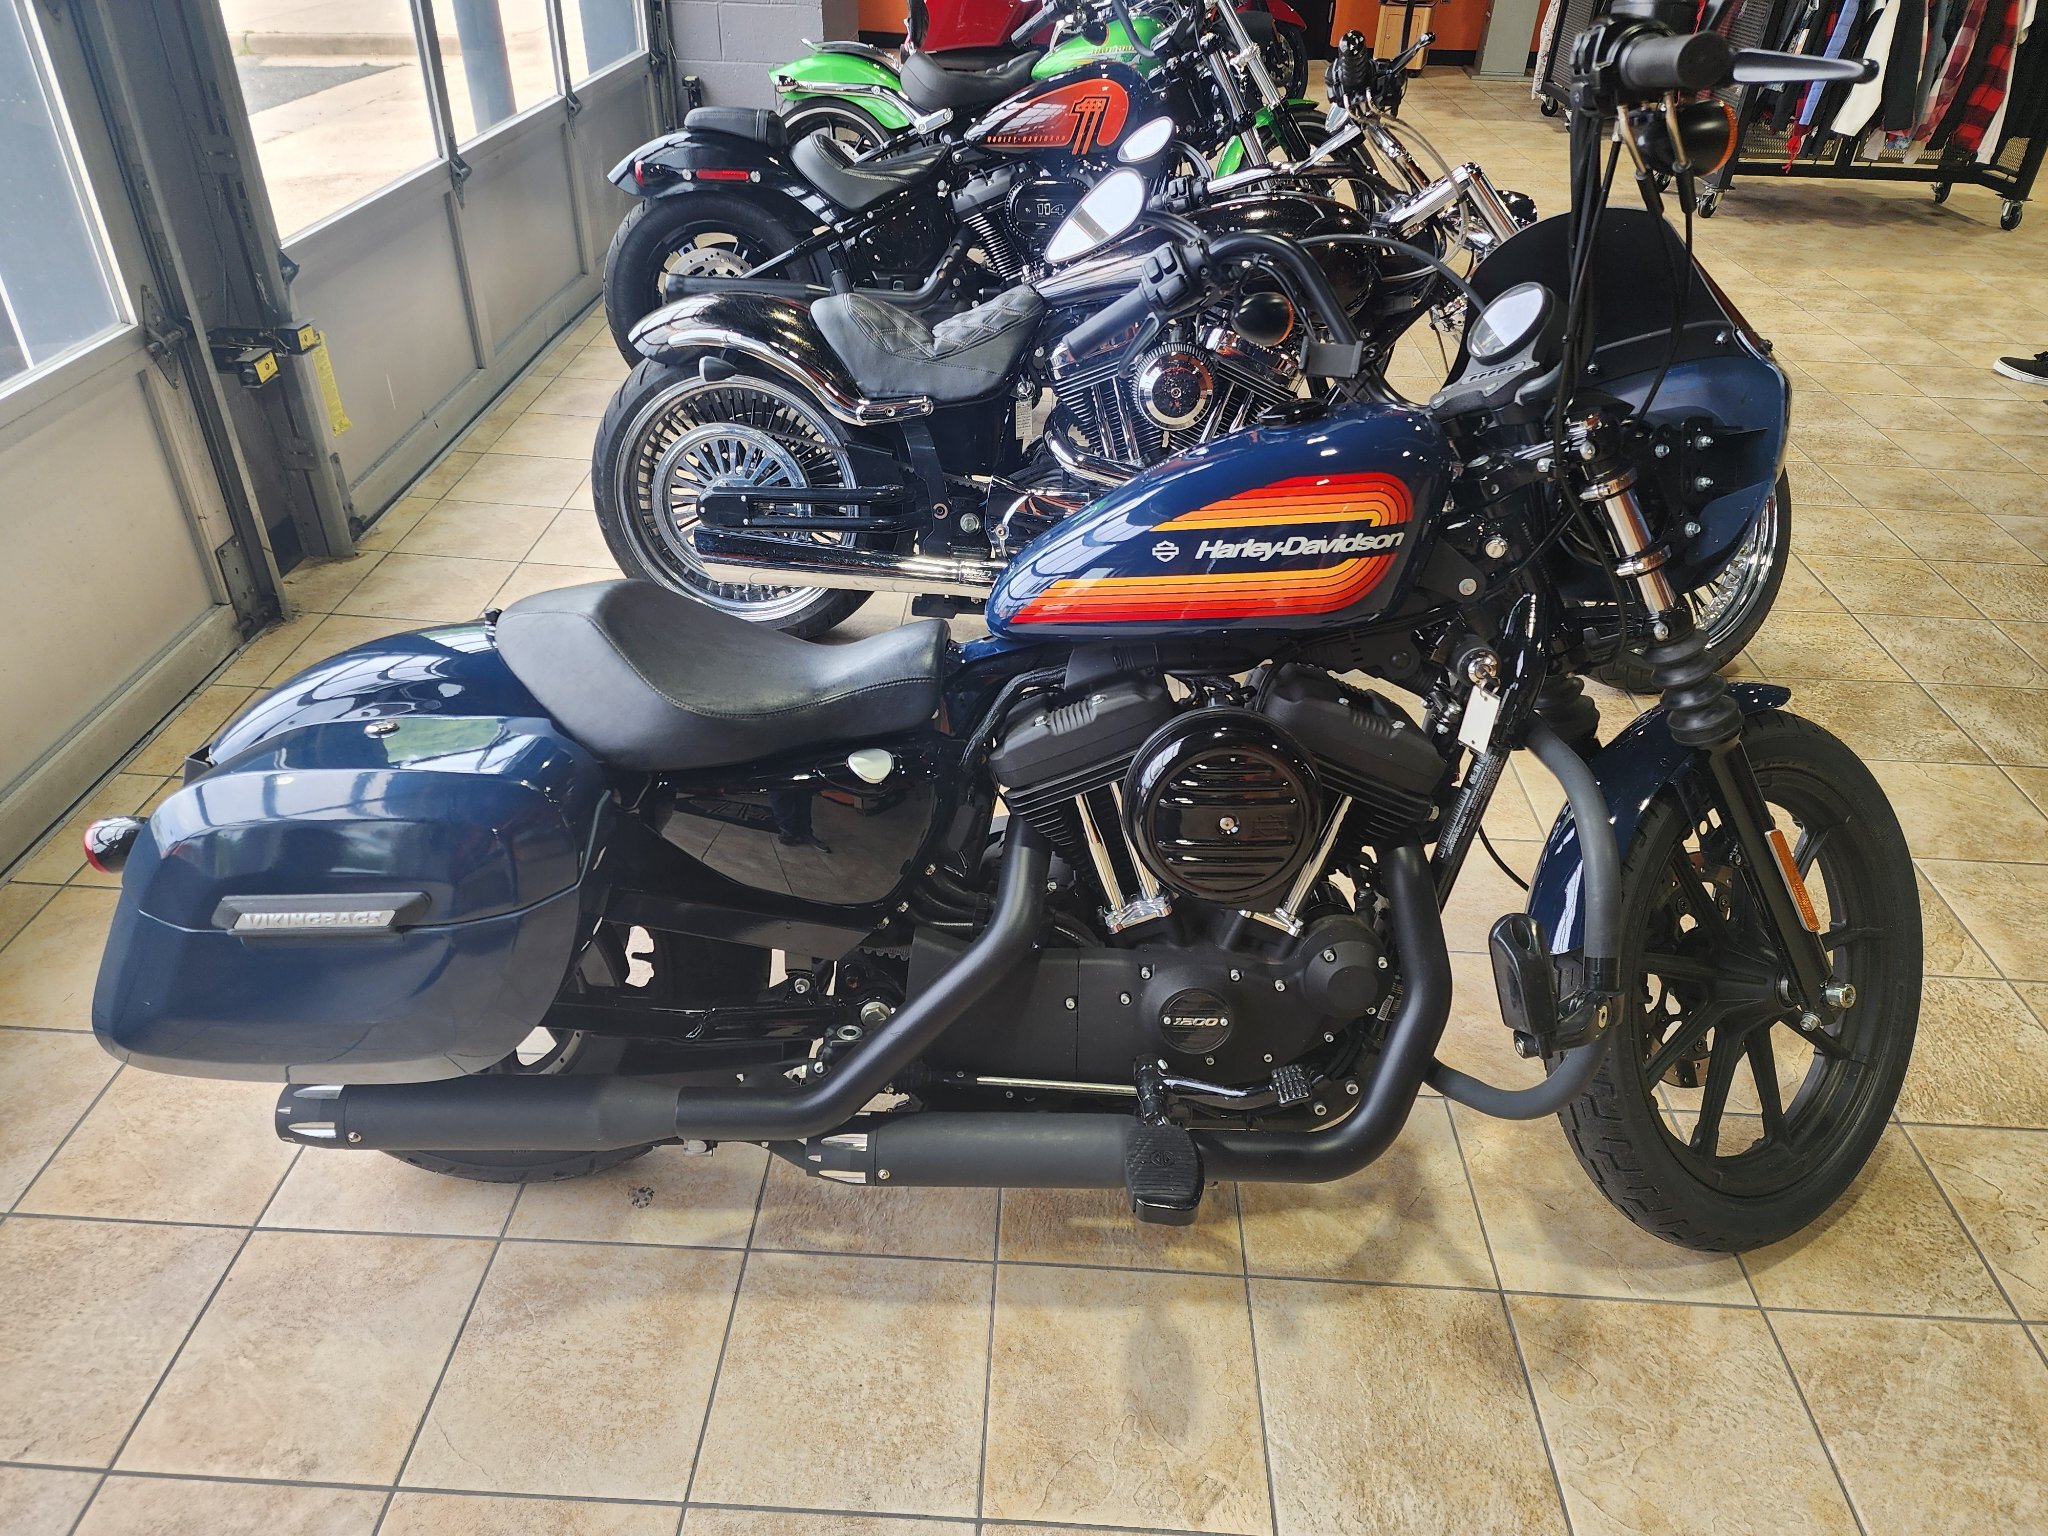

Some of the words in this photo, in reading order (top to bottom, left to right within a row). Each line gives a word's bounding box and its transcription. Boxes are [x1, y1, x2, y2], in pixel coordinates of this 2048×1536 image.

[1037, 203, 1066, 215] 114
[1195, 531, 1405, 561] Harley-Davidson
[243, 912, 382, 927] VIKINGBAGS
